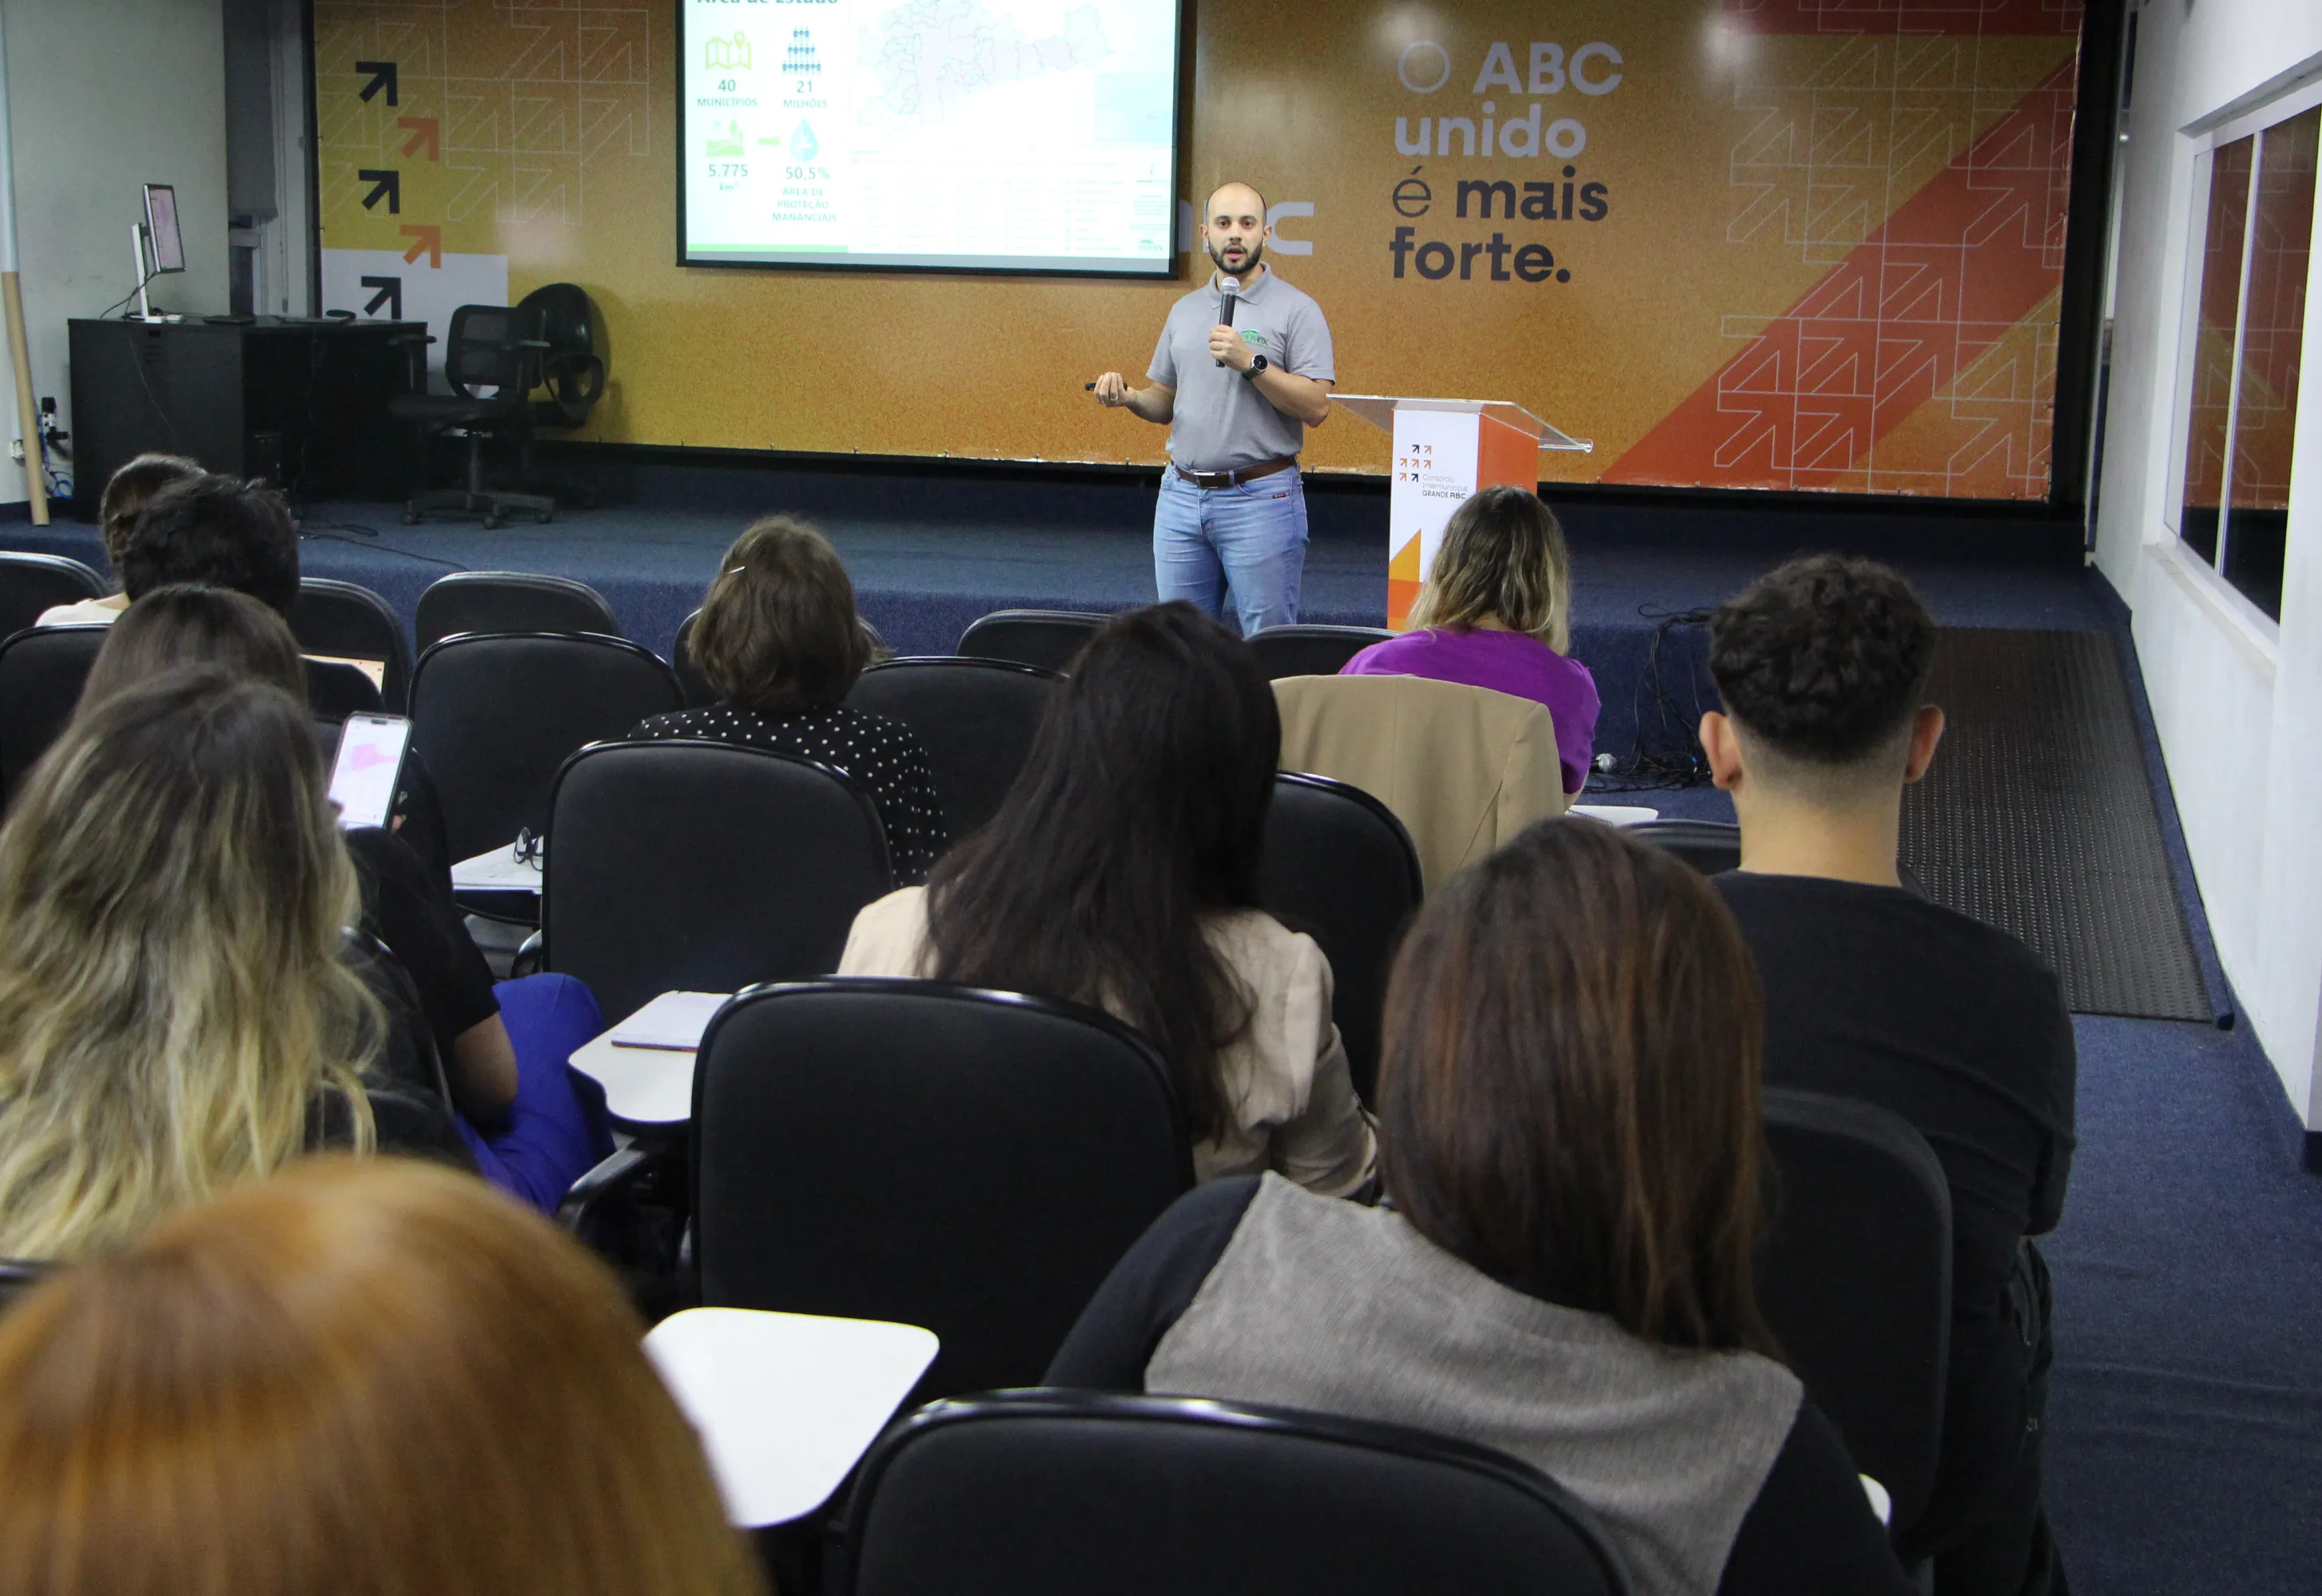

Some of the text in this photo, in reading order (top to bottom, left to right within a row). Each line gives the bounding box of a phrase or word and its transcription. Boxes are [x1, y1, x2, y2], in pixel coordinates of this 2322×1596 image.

[1398, 41, 1624, 95] O ABC
[718, 79, 737, 93] 40
[796, 80, 813, 93] 21
[697, 96, 758, 107] MUNICÍPIOS
[782, 97, 828, 109] MILHÕES
[1394, 101, 1587, 158] unido
[708, 163, 749, 177] 5.775
[785, 165, 832, 181] 50,5%
[811, 187, 825, 197] DE
[1393, 165, 1608, 221] é mais
[771, 212, 837, 222] MANANCIAIS
[1389, 226, 1571, 284] forte.
[1422, 474, 1455, 483] Consórcio
[1422, 482, 1468, 492] Intermunicipal
[1422, 490, 1449, 498] GRANDE
